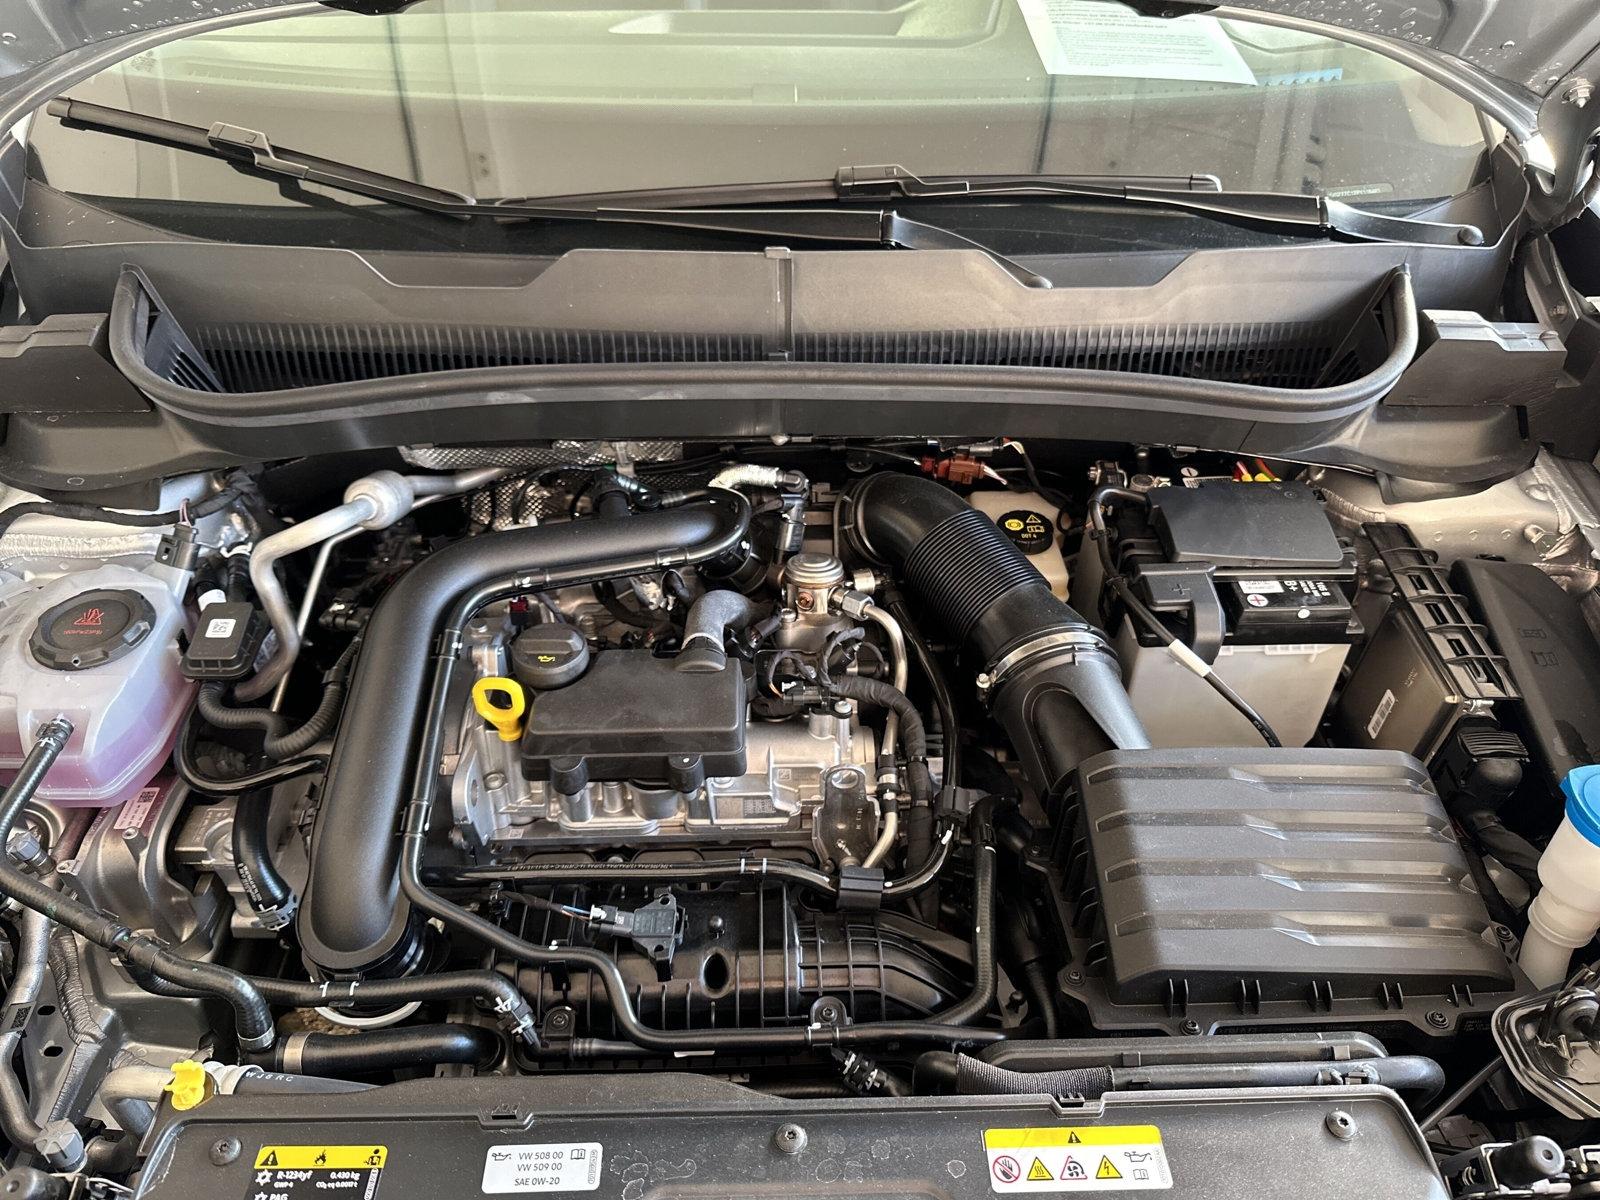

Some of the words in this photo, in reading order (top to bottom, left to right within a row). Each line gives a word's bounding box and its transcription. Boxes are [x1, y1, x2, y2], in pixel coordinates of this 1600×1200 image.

[518, 1152, 533, 1160] VW
[534, 1152, 552, 1160] 508
[552, 1151, 564, 1159] 00
[533, 1163, 551, 1171] 509
[551, 1162, 563, 1170] 00
[276, 1170, 313, 1181] R-1234yf
[514, 1177, 530, 1186] SAE
[531, 1176, 561, 1186] 0W-20
